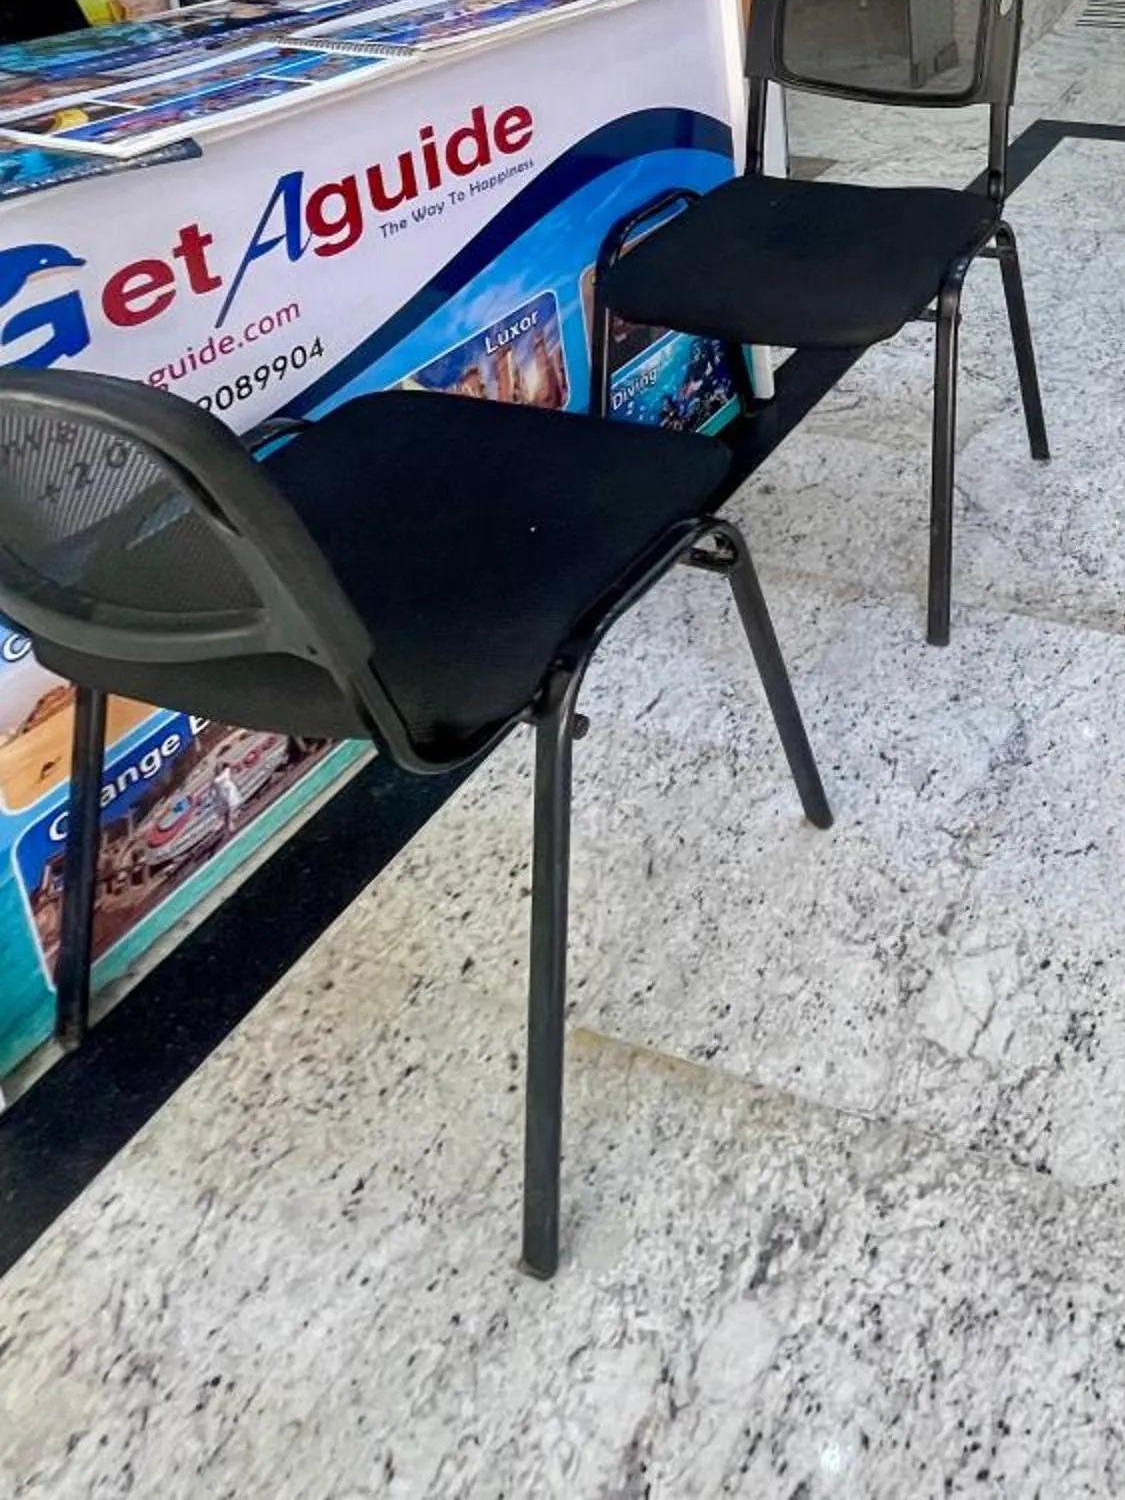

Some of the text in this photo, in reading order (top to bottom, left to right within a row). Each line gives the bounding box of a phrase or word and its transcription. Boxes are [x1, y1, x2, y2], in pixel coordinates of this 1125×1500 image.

[377, 159, 535, 239] The Way To Happiness
[0, 224, 223, 368] Get
[485, 310, 540, 354] Luxor
[611, 368, 659, 411] Diving
